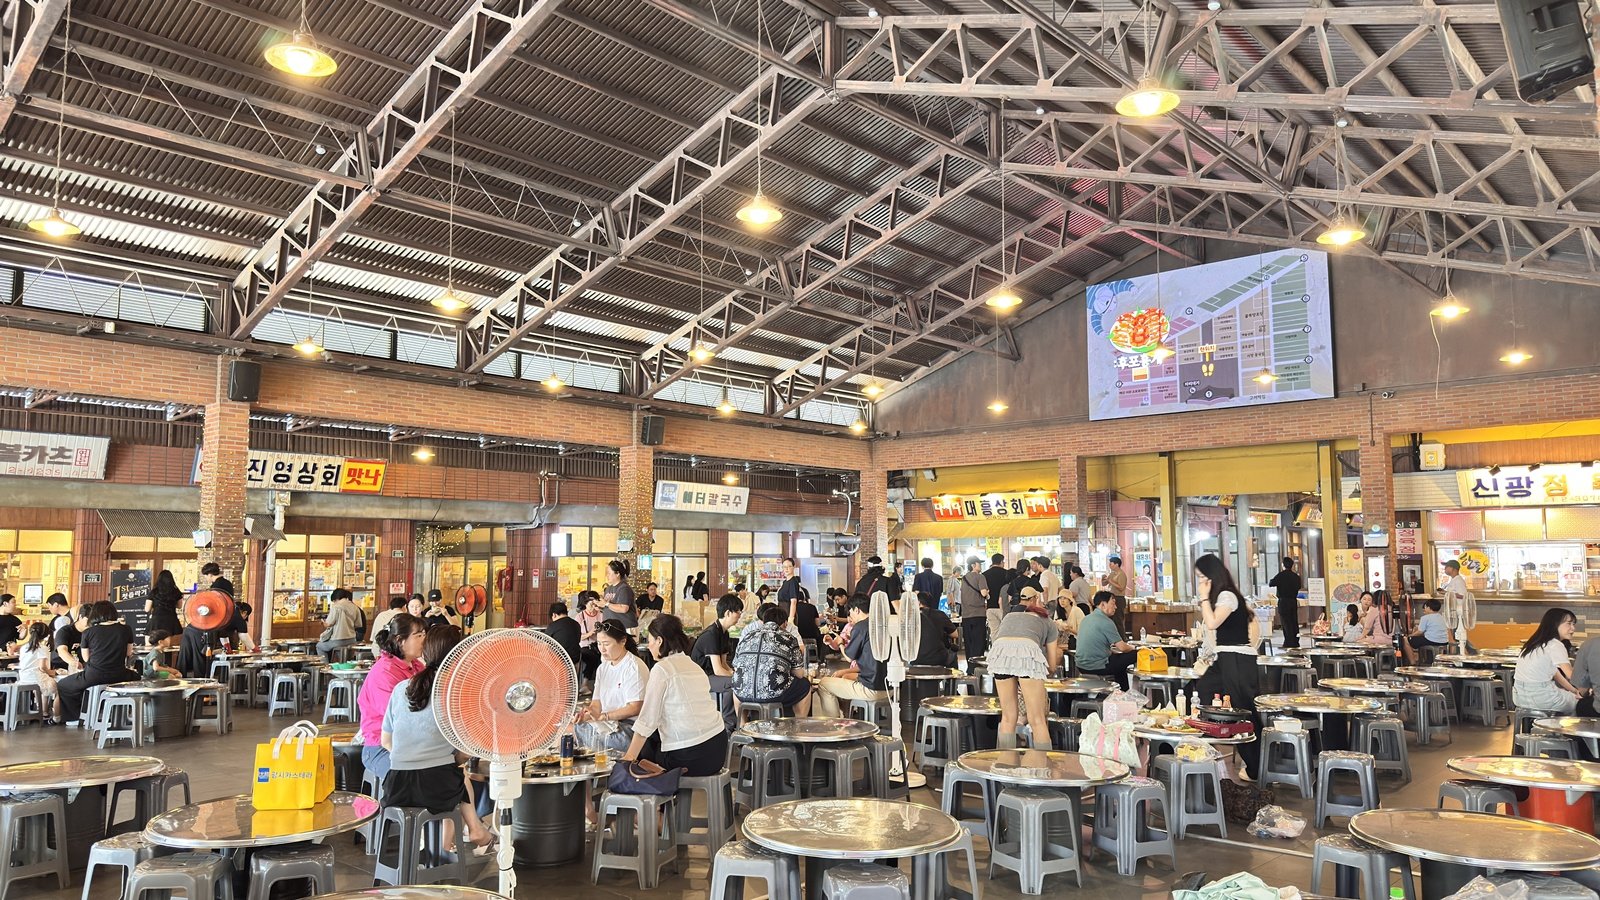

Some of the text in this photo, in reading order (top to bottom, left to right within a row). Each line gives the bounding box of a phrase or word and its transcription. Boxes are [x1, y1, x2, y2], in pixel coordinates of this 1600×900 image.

[1199, 345, 1215, 353] 현위치
[247, 458, 381, 486] 진영상회 맛나
[1471, 476, 1534, 498] 신광
[965, 498, 1024, 517] 대흥상회
